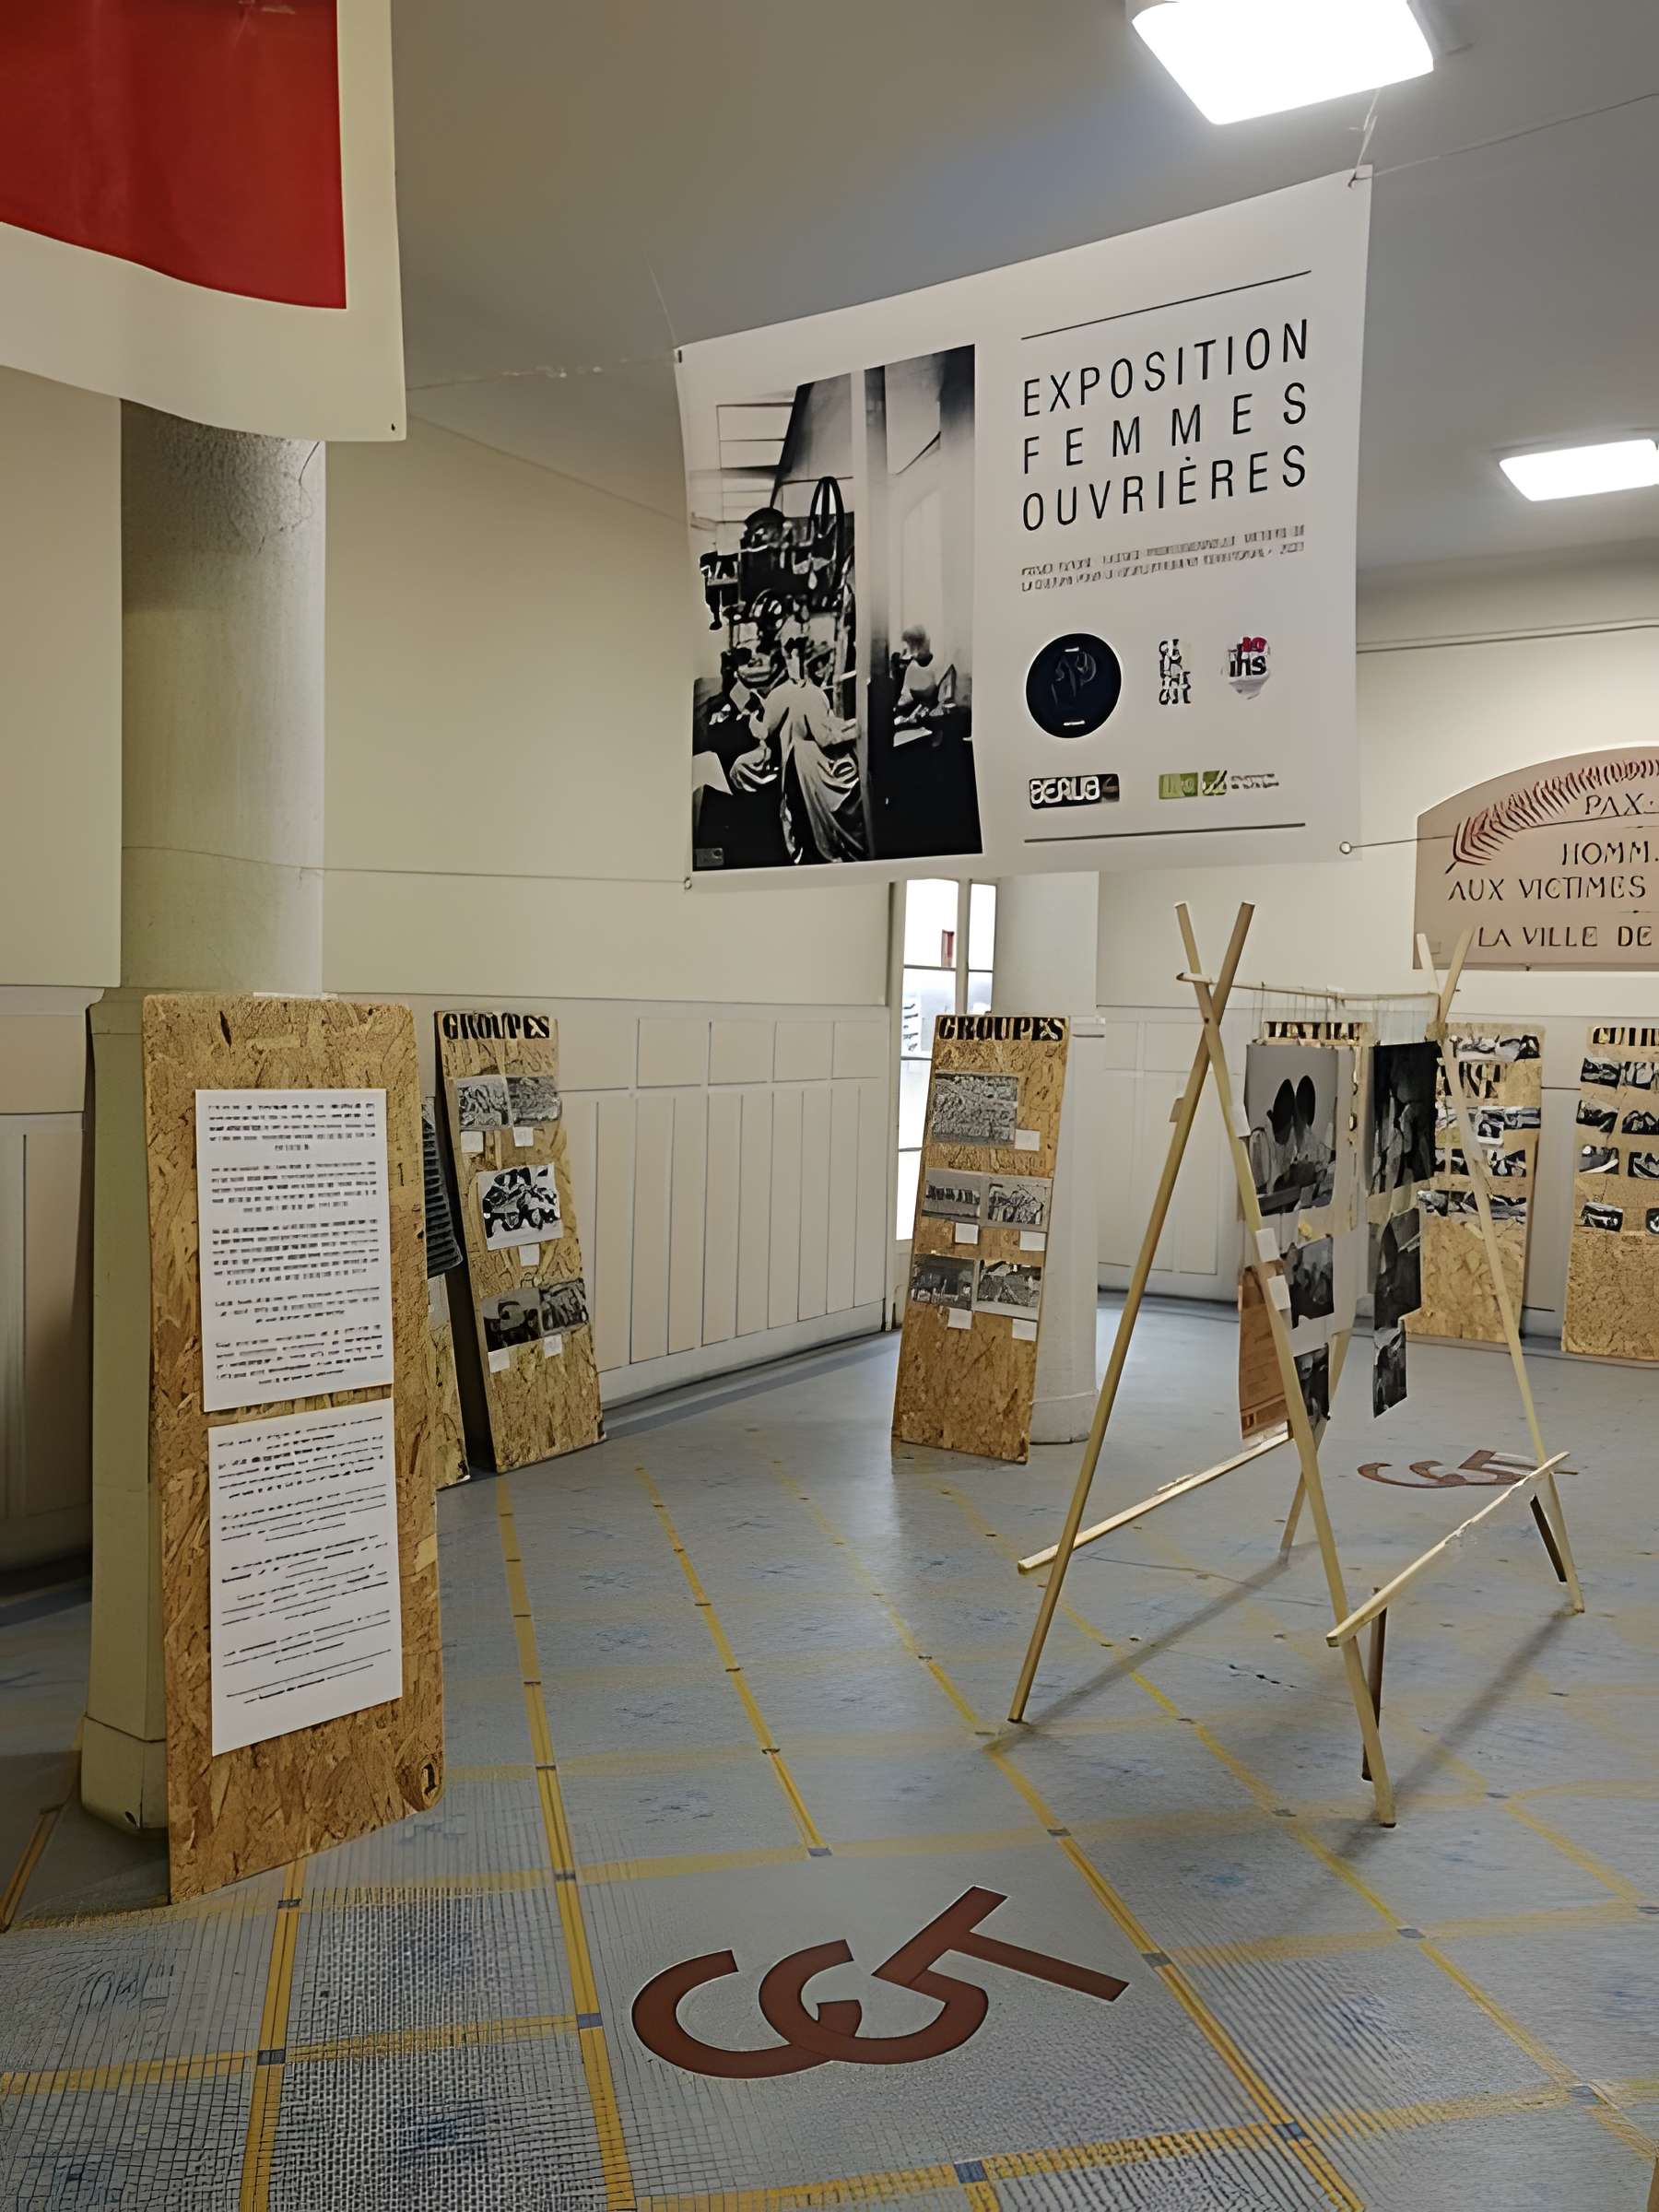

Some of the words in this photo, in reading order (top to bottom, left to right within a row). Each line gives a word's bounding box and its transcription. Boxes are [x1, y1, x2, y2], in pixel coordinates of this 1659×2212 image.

[1024, 318, 1308, 417] EXPOSITION
[1024, 382, 1306, 475] FEMMES
[1448, 878, 1505, 900] AUX
[1518, 876, 1646, 900] VICTIMES
[1477, 926, 1512, 947] LA
[1523, 926, 1598, 947] VILLE
[1618, 925, 1653, 947] DE
[938, 1016, 1064, 1041] GROUPES
[631, 1885, 1130, 2079] CGT
